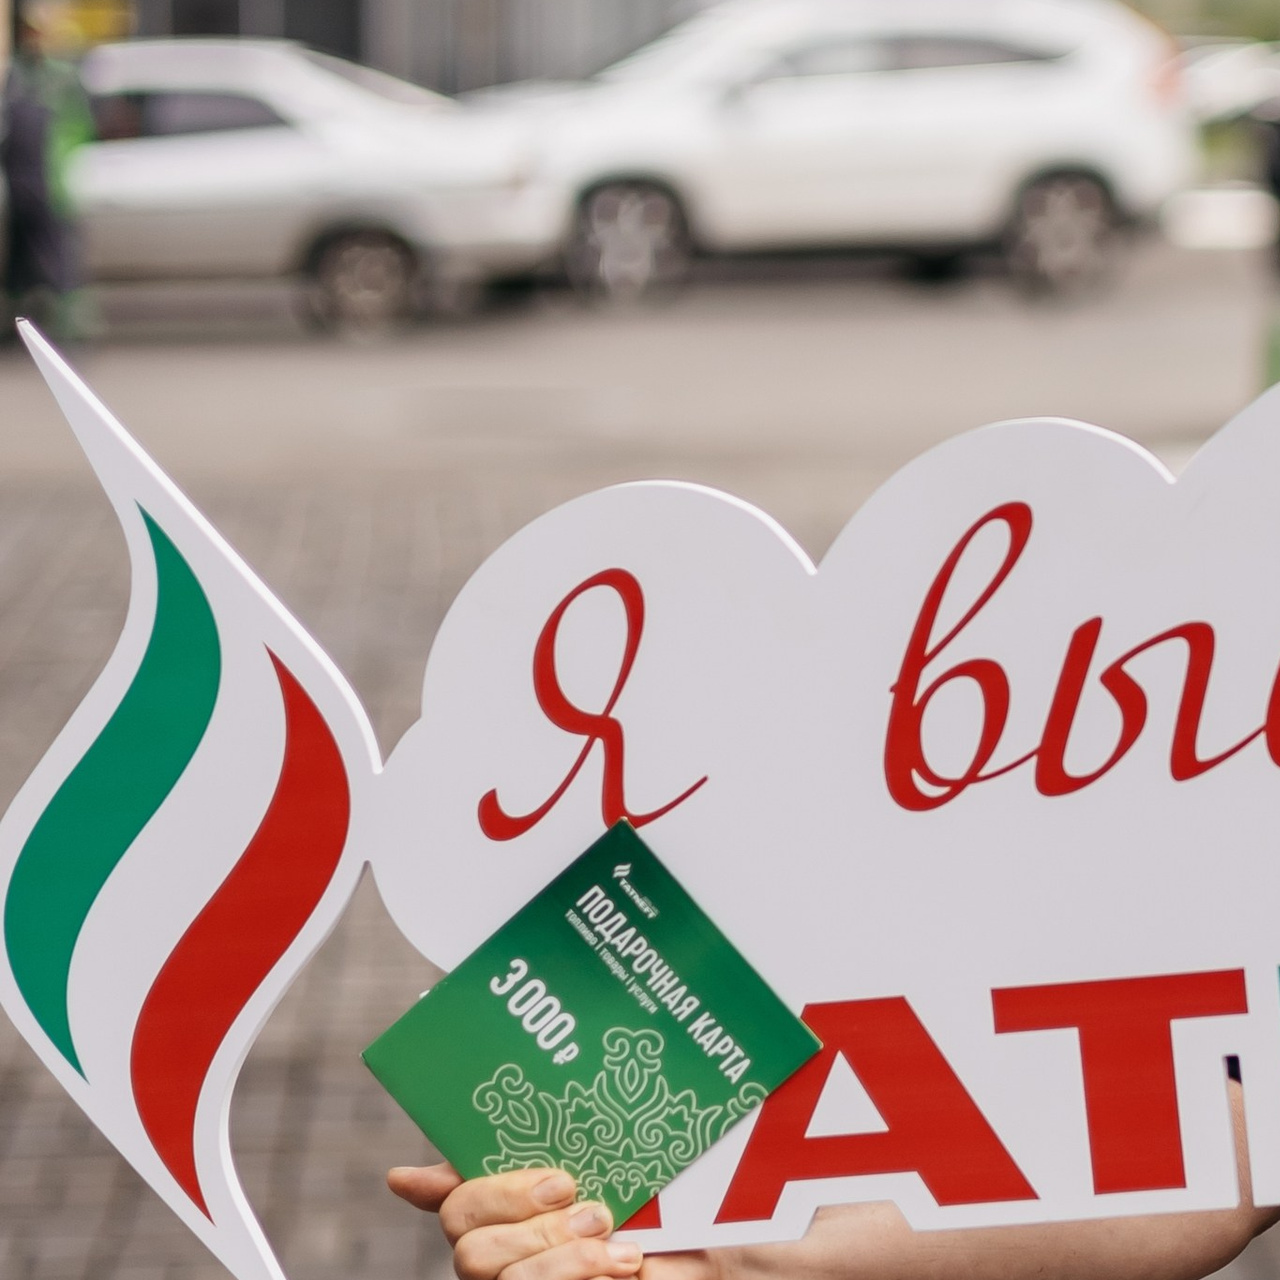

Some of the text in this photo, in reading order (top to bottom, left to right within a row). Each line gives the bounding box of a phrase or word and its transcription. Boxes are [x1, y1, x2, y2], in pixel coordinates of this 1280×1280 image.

[478, 567, 708, 841] Я
[564, 908, 658, 1014] топливо товары услуги
[575, 884, 751, 1085] ПОДАРОЧНАЯ КАРТА
